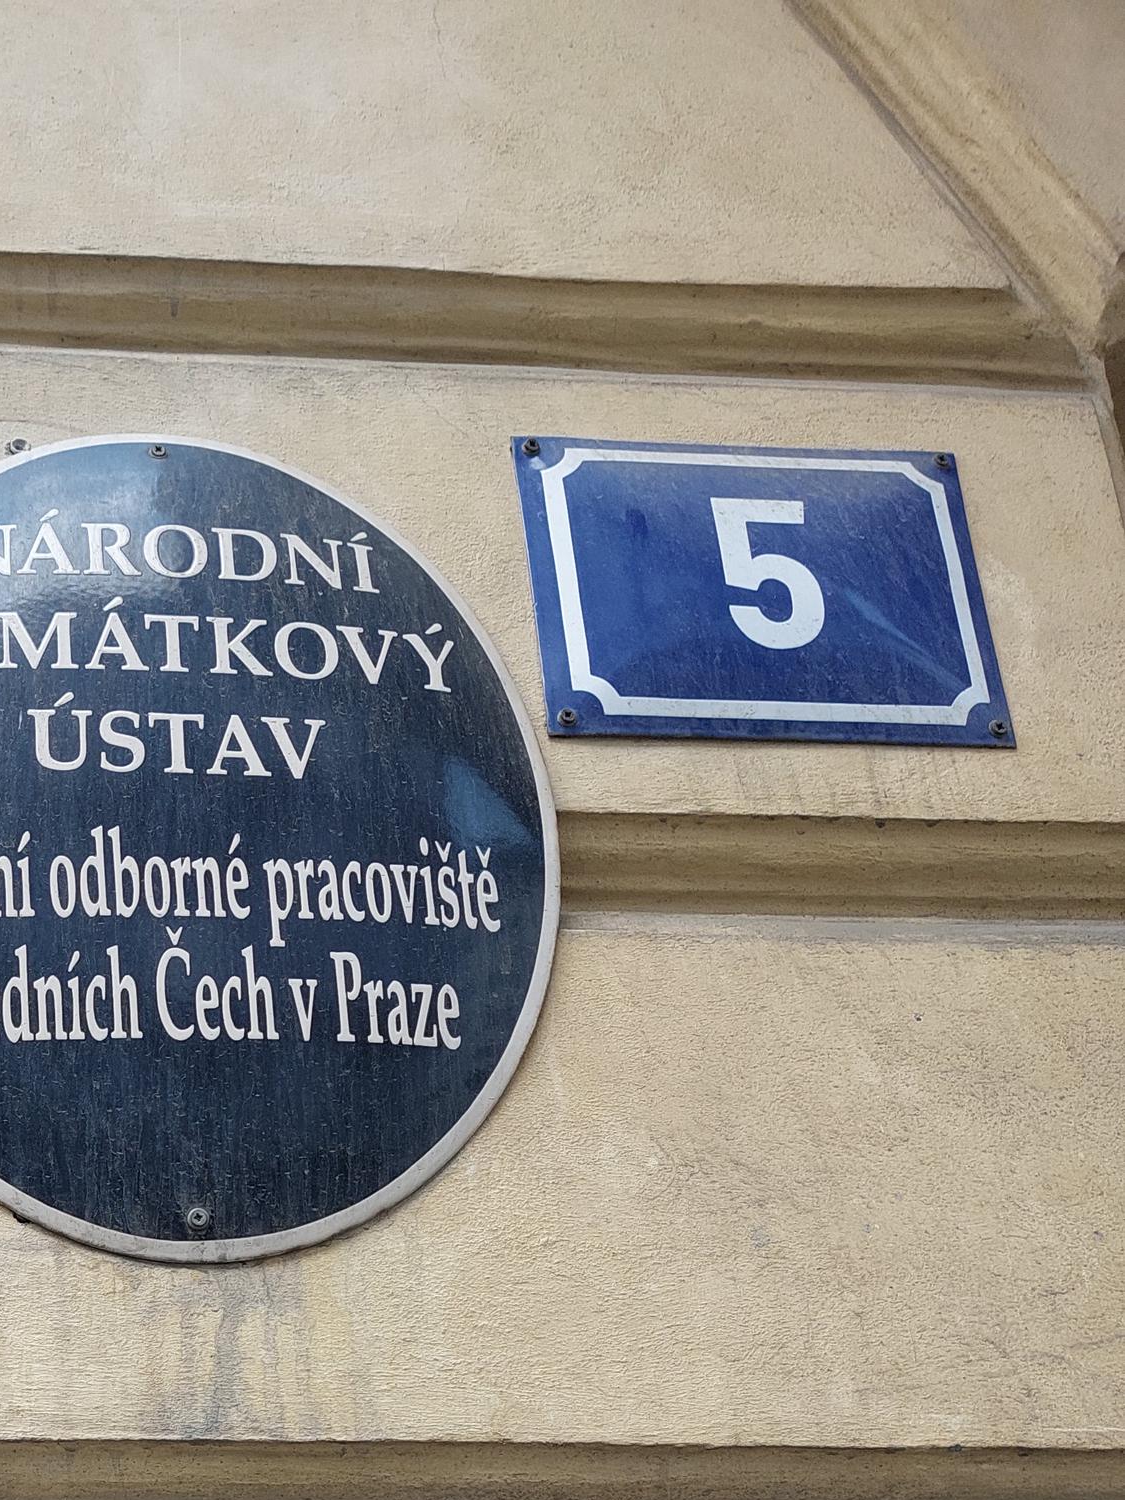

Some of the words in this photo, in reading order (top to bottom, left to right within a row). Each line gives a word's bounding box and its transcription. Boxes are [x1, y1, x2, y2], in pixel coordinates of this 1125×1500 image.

[710, 497, 825, 650] 5
[27, 692, 326, 779] ÚSTAV
[49, 826, 250, 920] odborné
[263, 836, 501, 947] pracoviště
[155, 928, 279, 1043] Čech
[289, 976, 318, 1041] v
[335, 950, 462, 1050] Praze
